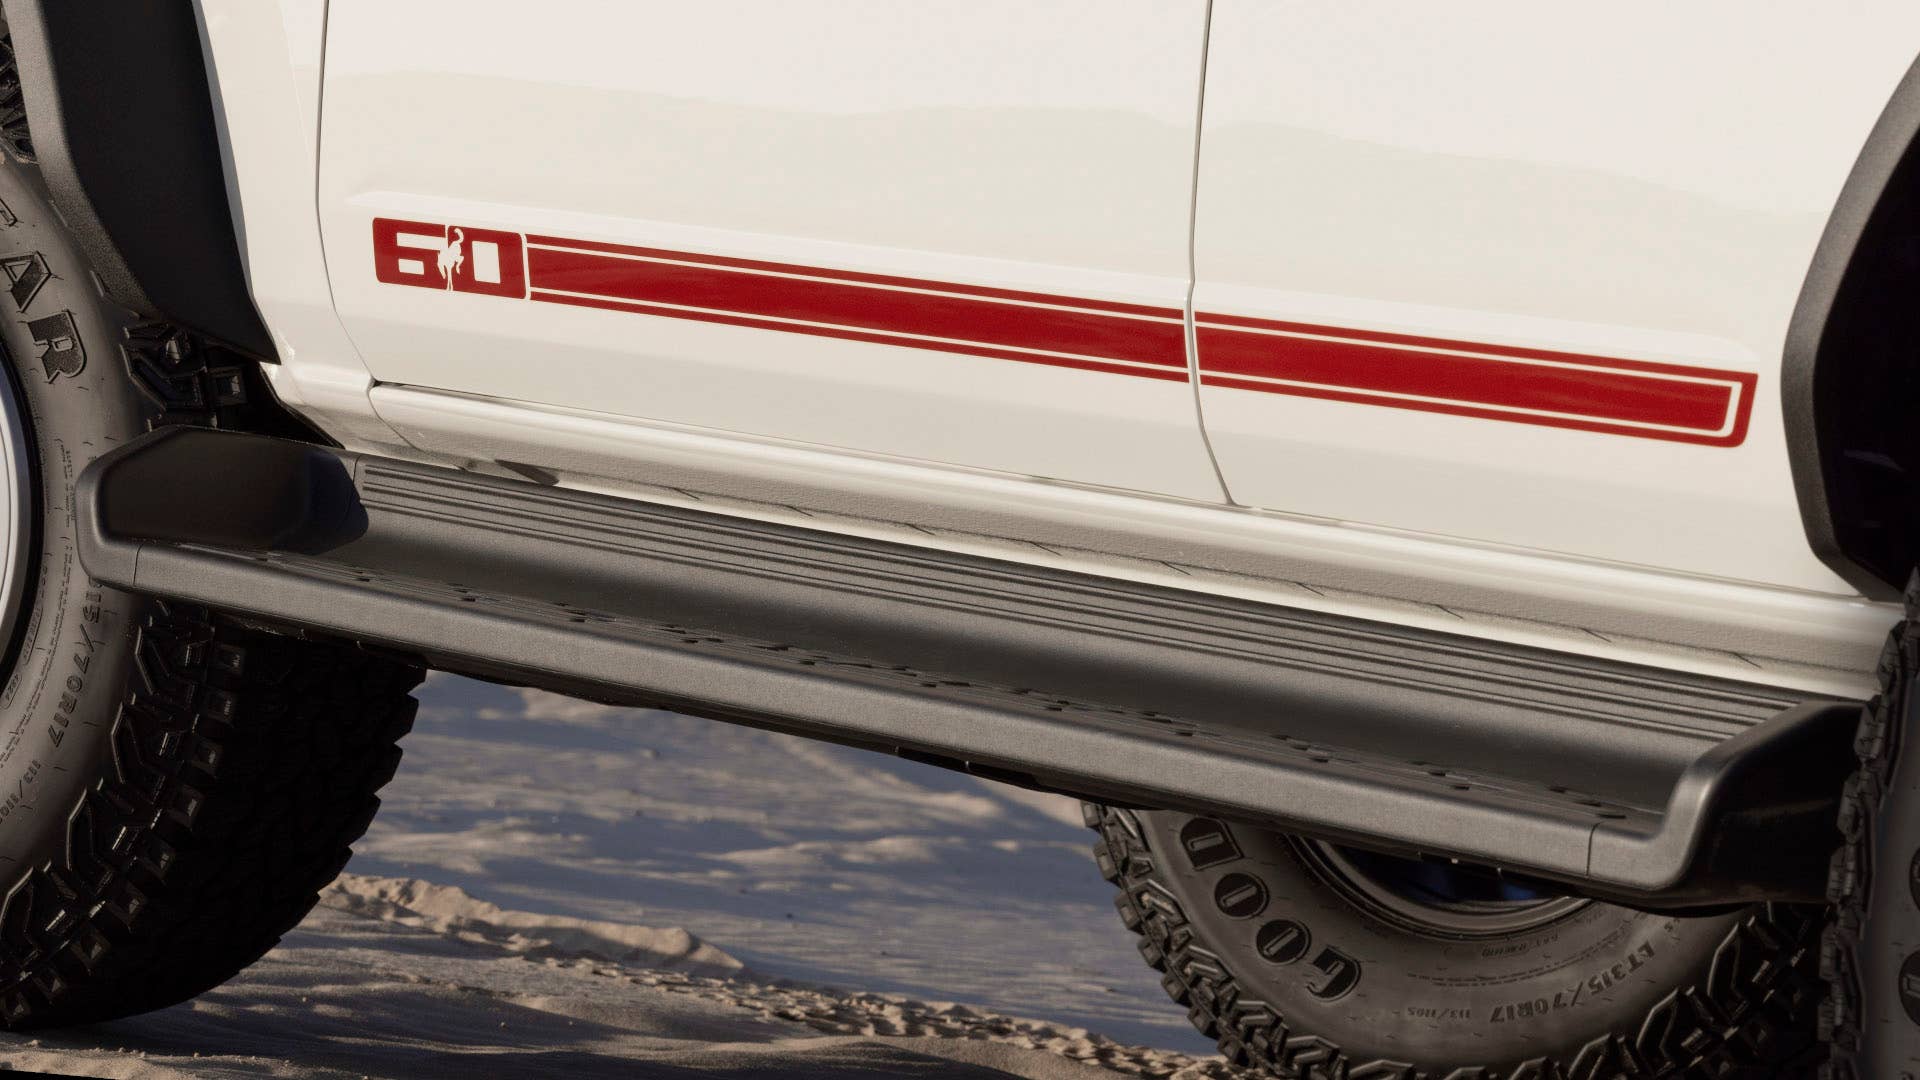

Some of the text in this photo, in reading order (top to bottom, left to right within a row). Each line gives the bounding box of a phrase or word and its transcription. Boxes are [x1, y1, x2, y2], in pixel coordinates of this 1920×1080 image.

[0, 196, 87, 384] AR
[373, 217, 527, 300] 60
[1180, 816, 1361, 1002] GOOD
[1490, 938, 1656, 1023] LT315/70R17
